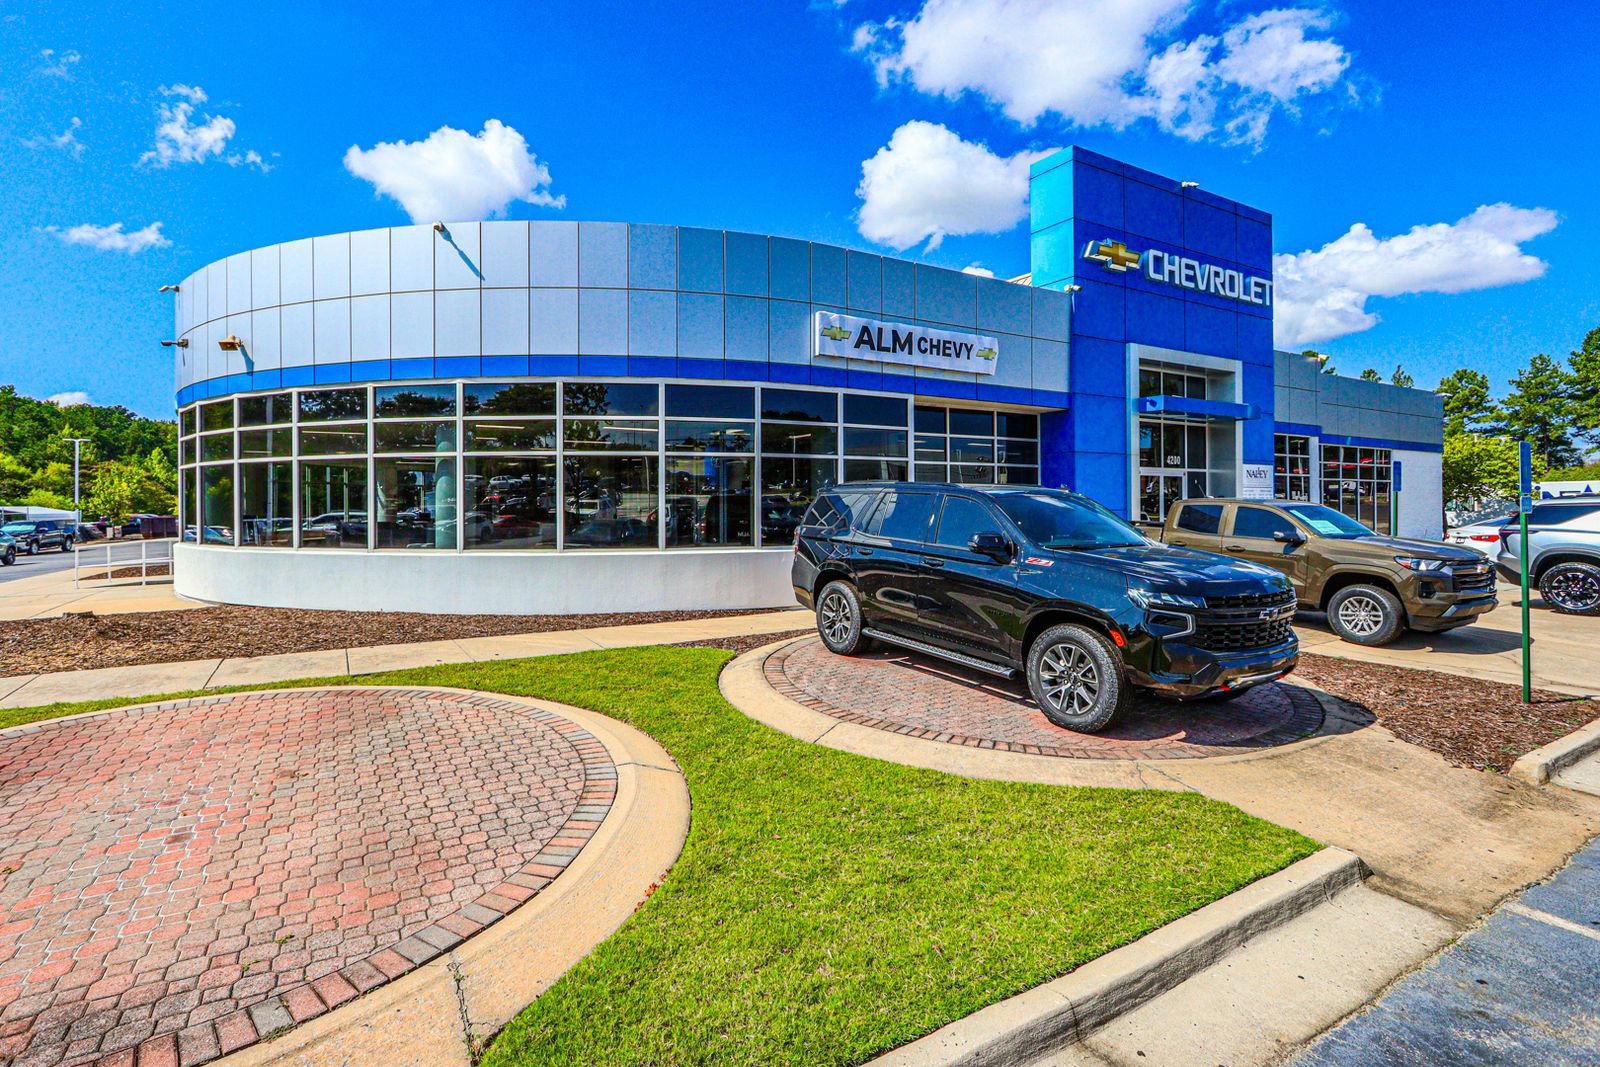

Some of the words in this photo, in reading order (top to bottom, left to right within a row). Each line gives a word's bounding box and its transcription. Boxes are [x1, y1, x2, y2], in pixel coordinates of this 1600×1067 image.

[1147, 249, 1273, 306] CHEVROLET
[854, 325, 914, 355] ALM
[917, 336, 974, 360] CHEVY
[1166, 455, 1181, 465] 4200
